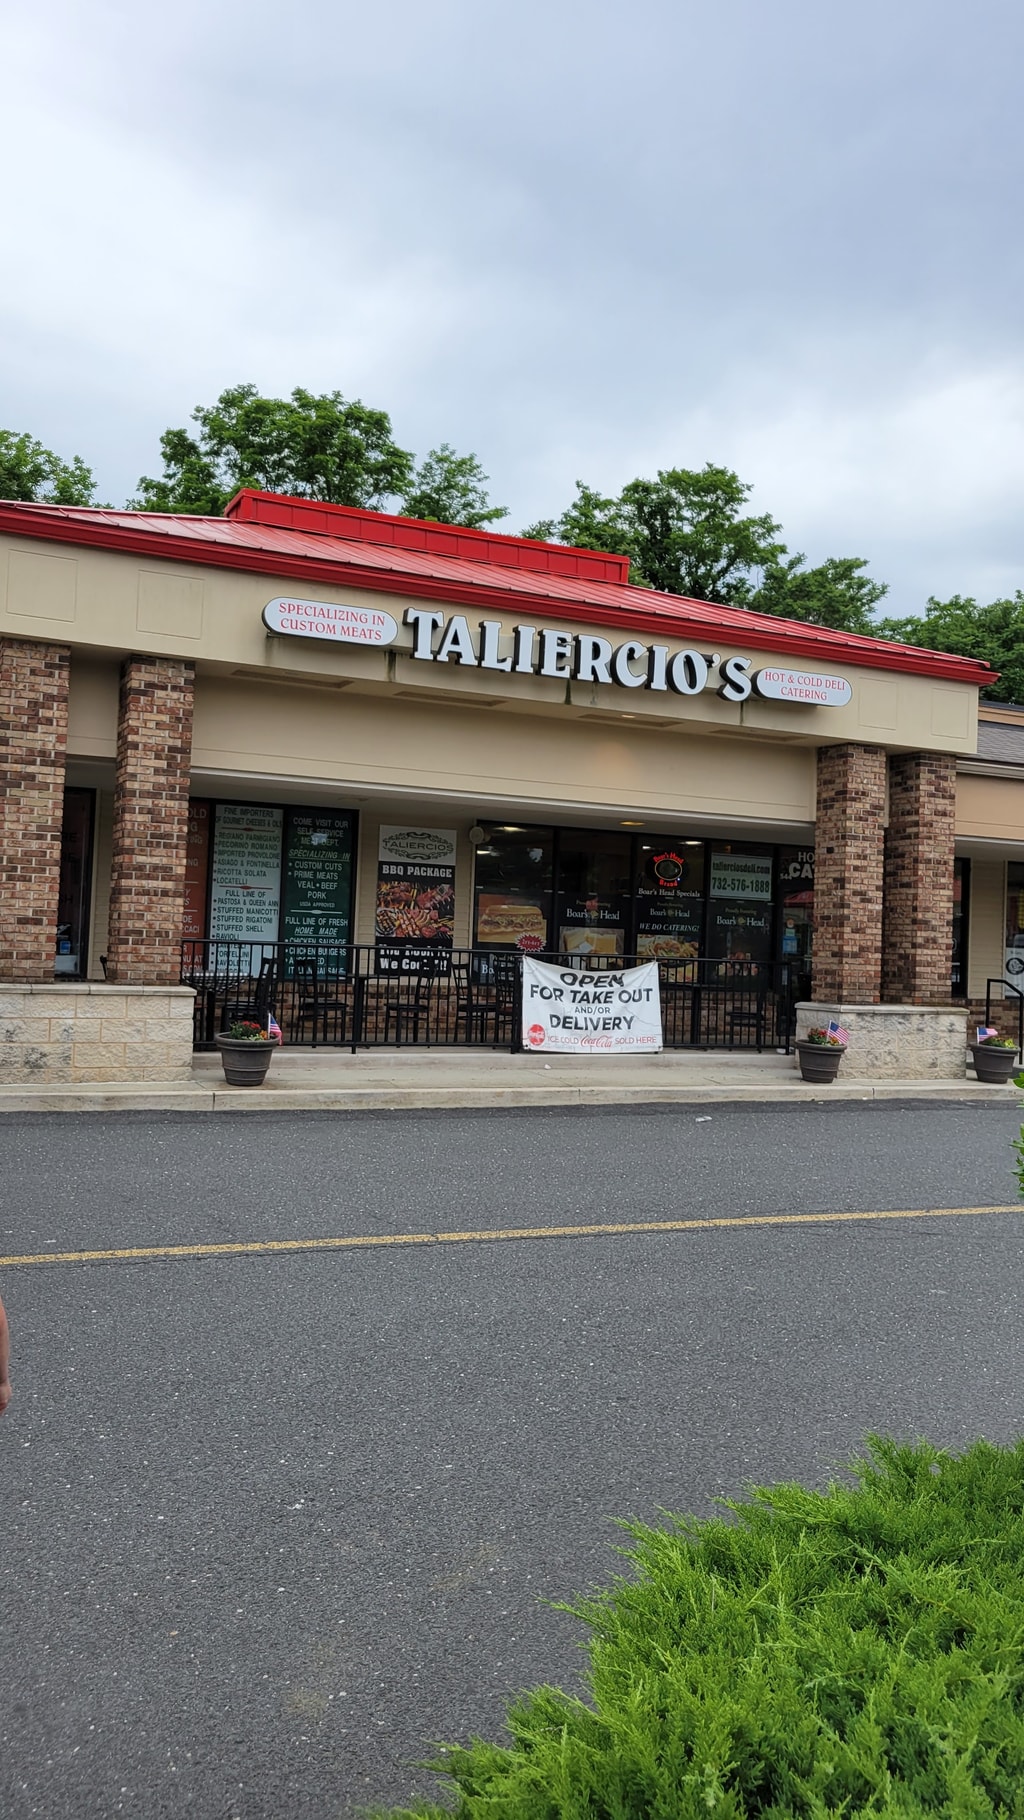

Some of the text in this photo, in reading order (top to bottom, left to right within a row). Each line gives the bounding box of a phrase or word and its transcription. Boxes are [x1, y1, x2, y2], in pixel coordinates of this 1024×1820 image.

[279, 602, 386, 626] SPECIALIZING IN
[280, 618, 382, 641] CUSTOM MEATS
[402, 607, 752, 702] TALIERCIO'S
[765, 671, 846, 691] HOT & COLD DELI
[780, 686, 828, 701] CATERING
[223, 807, 274, 818] FINE IMPORTERS
[292, 816, 349, 828] COME VISIT OUR
[251, 842, 278, 851] ROMANO
[288, 848, 351, 860] SPECIALIZING IN
[294, 861, 343, 871] CUSTOM CUTS
[382, 864, 453, 878] BBQ PACKAGE
[788, 862, 815, 879] CA
[217, 867, 242, 876] RICOTTA
[294, 870, 339, 880] PRIME MEATS
[216, 876, 248, 885] LOCATELLI
[297, 880, 338, 890] VEAL BEEF
[711, 876, 770, 893] 732-576-1888
[225, 889, 240, 897] FULL
[242, 890, 255, 898] LINE
[307, 891, 327, 899] PORK
[638, 888, 701, 898] Boar's Head Specials
[217, 897, 240, 906] PASTOSA
[248, 899, 266, 907] QUEEN
[217, 906, 279, 916] STUFFED MANICOTTI
[566, 908, 620, 920] Boar's Head
[674, 909, 690, 918] Head
[216, 915, 273, 924] STUFFED RIGATONI
[285, 916, 349, 927] FULL LINE OF FRESH
[716, 915, 765, 927] Boar's Head
[216, 924, 243, 932] STUFFED
[294, 926, 339, 936] HOME MADE
[639, 922, 651, 930] WE
[663, 923, 700, 932] CATERING!
[379, 957, 398, 970] We
[559, 972, 626, 989] OPEN
[530, 983, 653, 1004] FOR TAKE OUT
[574, 1006, 611, 1015] AND/OR
[549, 1014, 635, 1031] DELIVERY
[547, 1036, 560, 1044] ICE
[560, 1036, 579, 1044] COLD
[615, 1037, 635, 1045] SOLD
[636, 1036, 657, 1044] HERE
